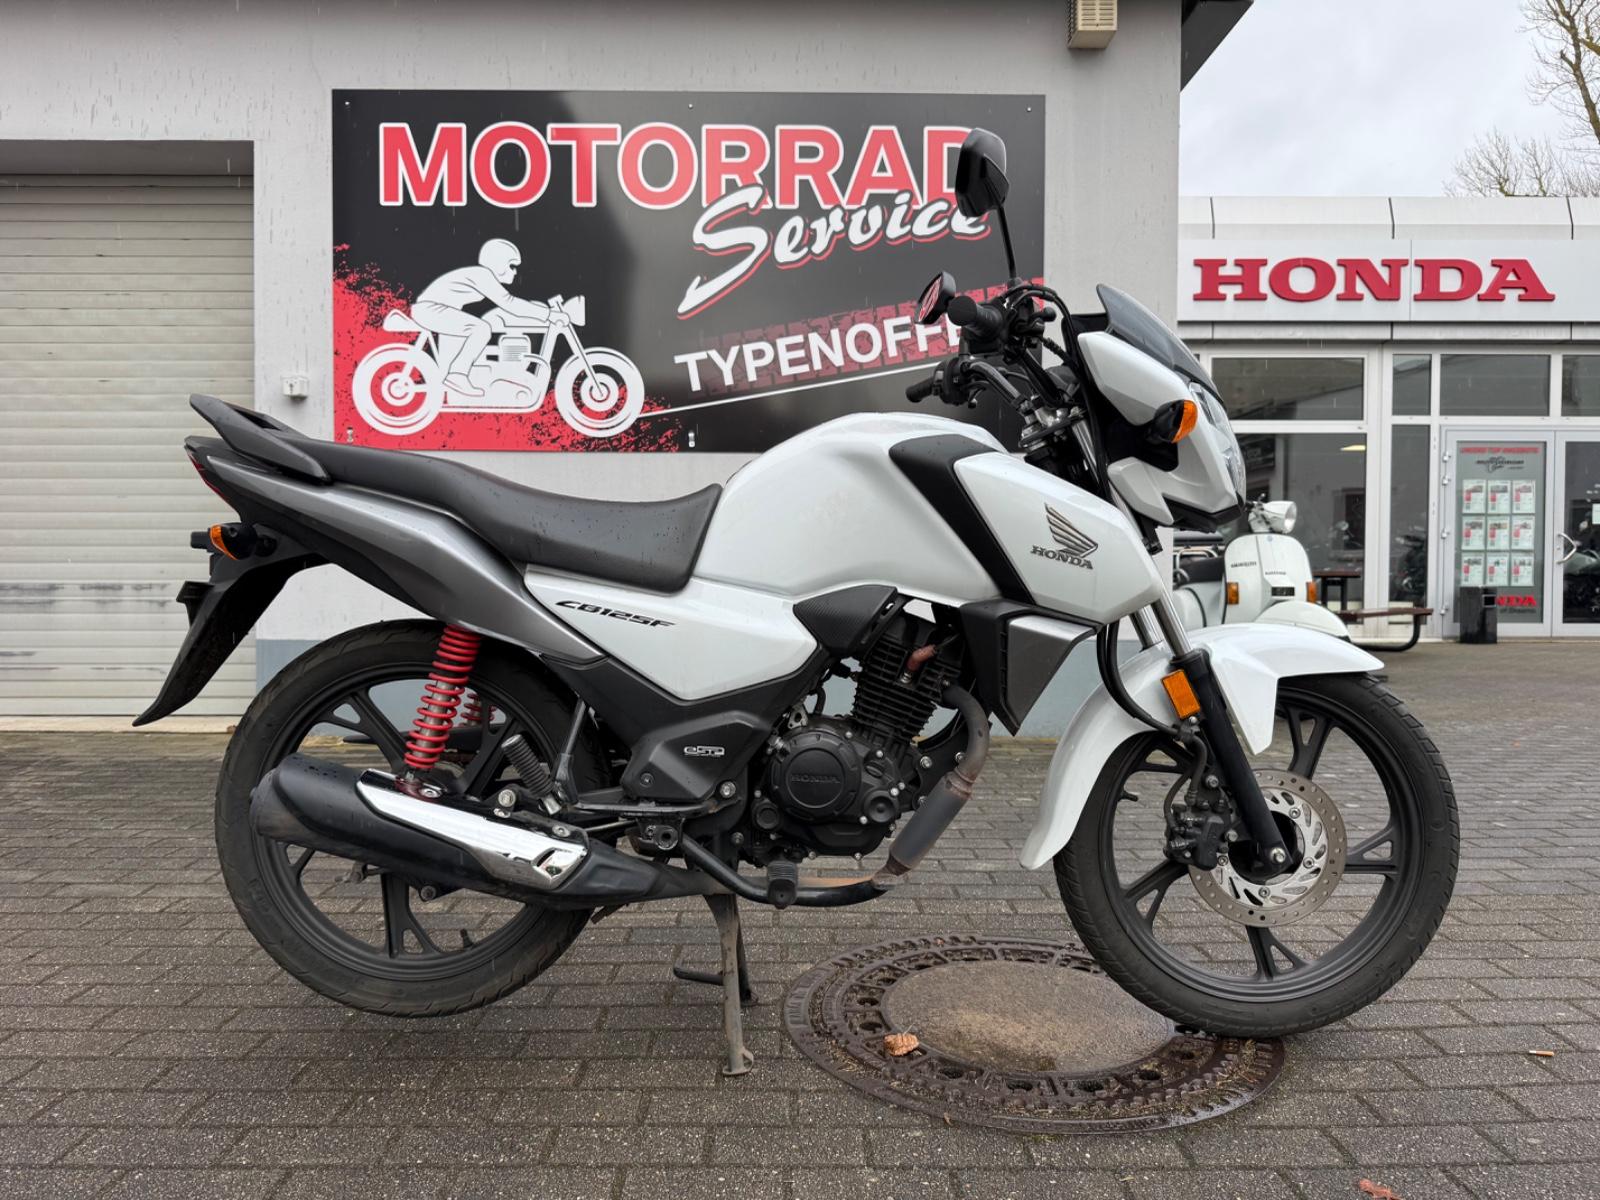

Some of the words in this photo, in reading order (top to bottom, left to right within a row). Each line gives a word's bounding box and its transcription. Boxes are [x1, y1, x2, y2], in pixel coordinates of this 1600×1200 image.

[378, 122, 974, 210] MOTORRAD
[1192, 257, 1556, 303] HONDA
[1030, 544, 1094, 570] HONDA
[555, 600, 677, 627] CB125F
